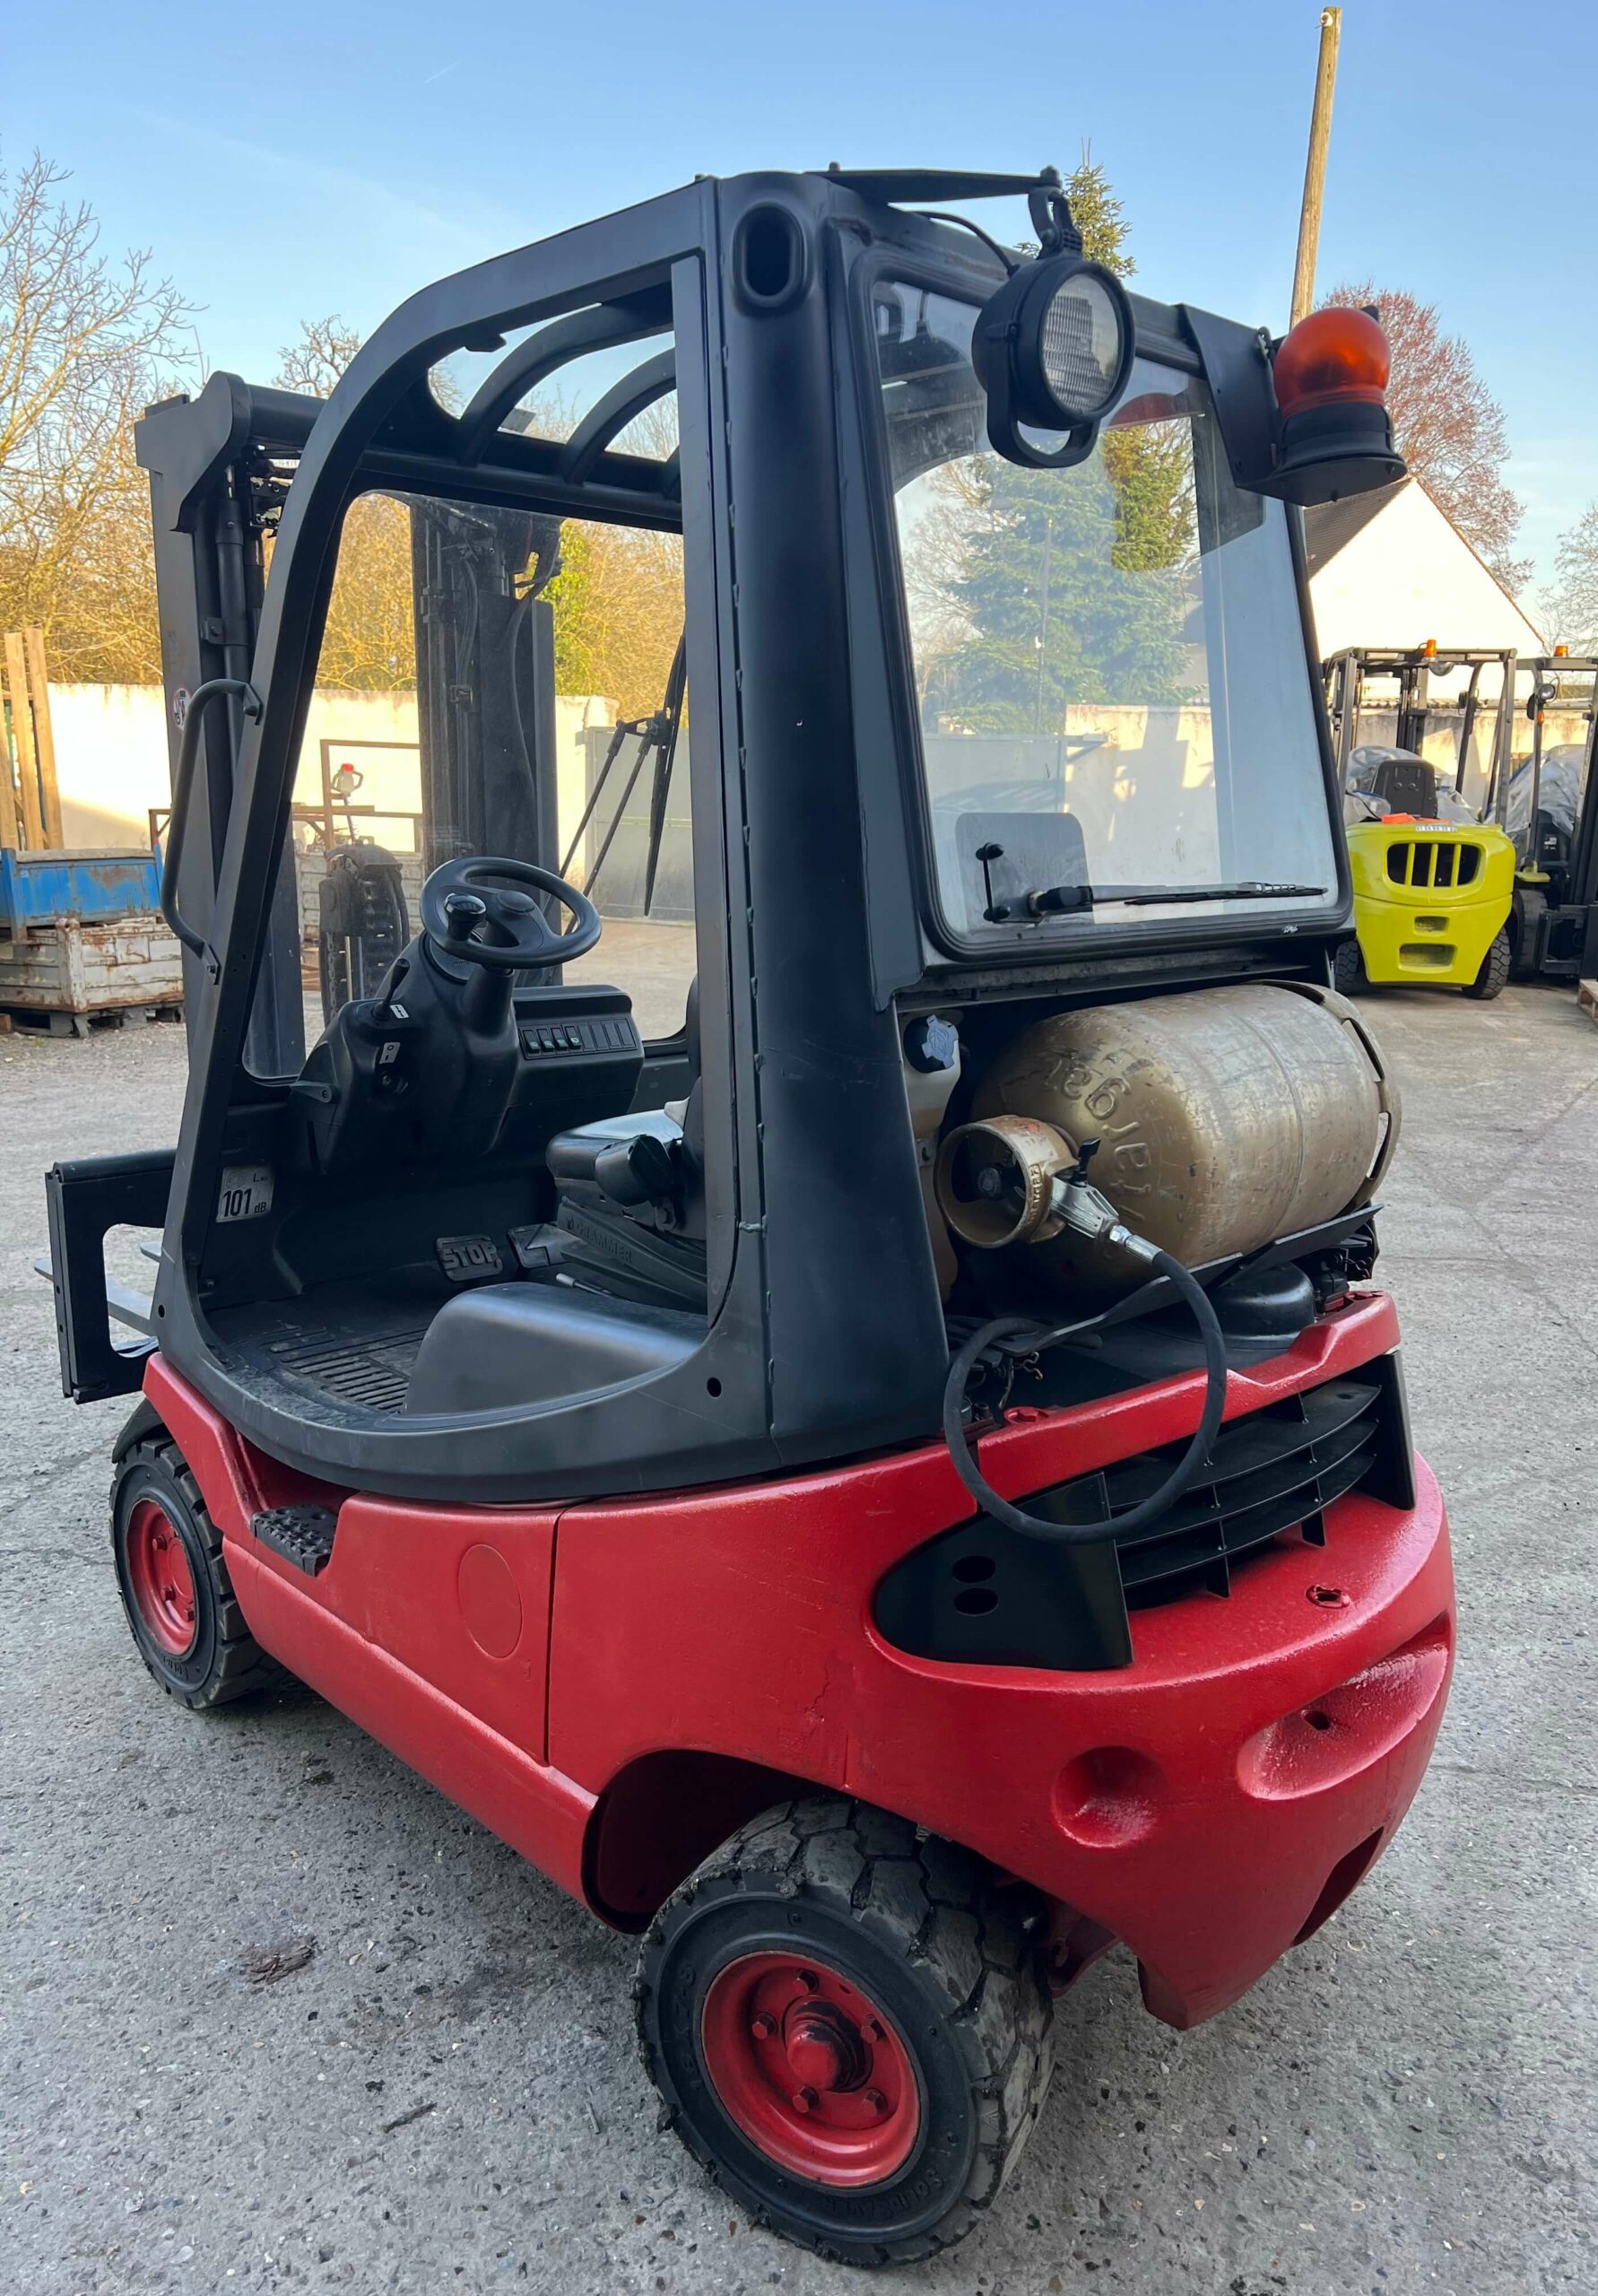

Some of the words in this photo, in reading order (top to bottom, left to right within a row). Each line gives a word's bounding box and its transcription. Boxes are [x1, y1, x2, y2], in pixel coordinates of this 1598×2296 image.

[223, 1188, 252, 1217] 101
[255, 1202, 267, 1213] dB
[442, 1243, 498, 1270] STOP
